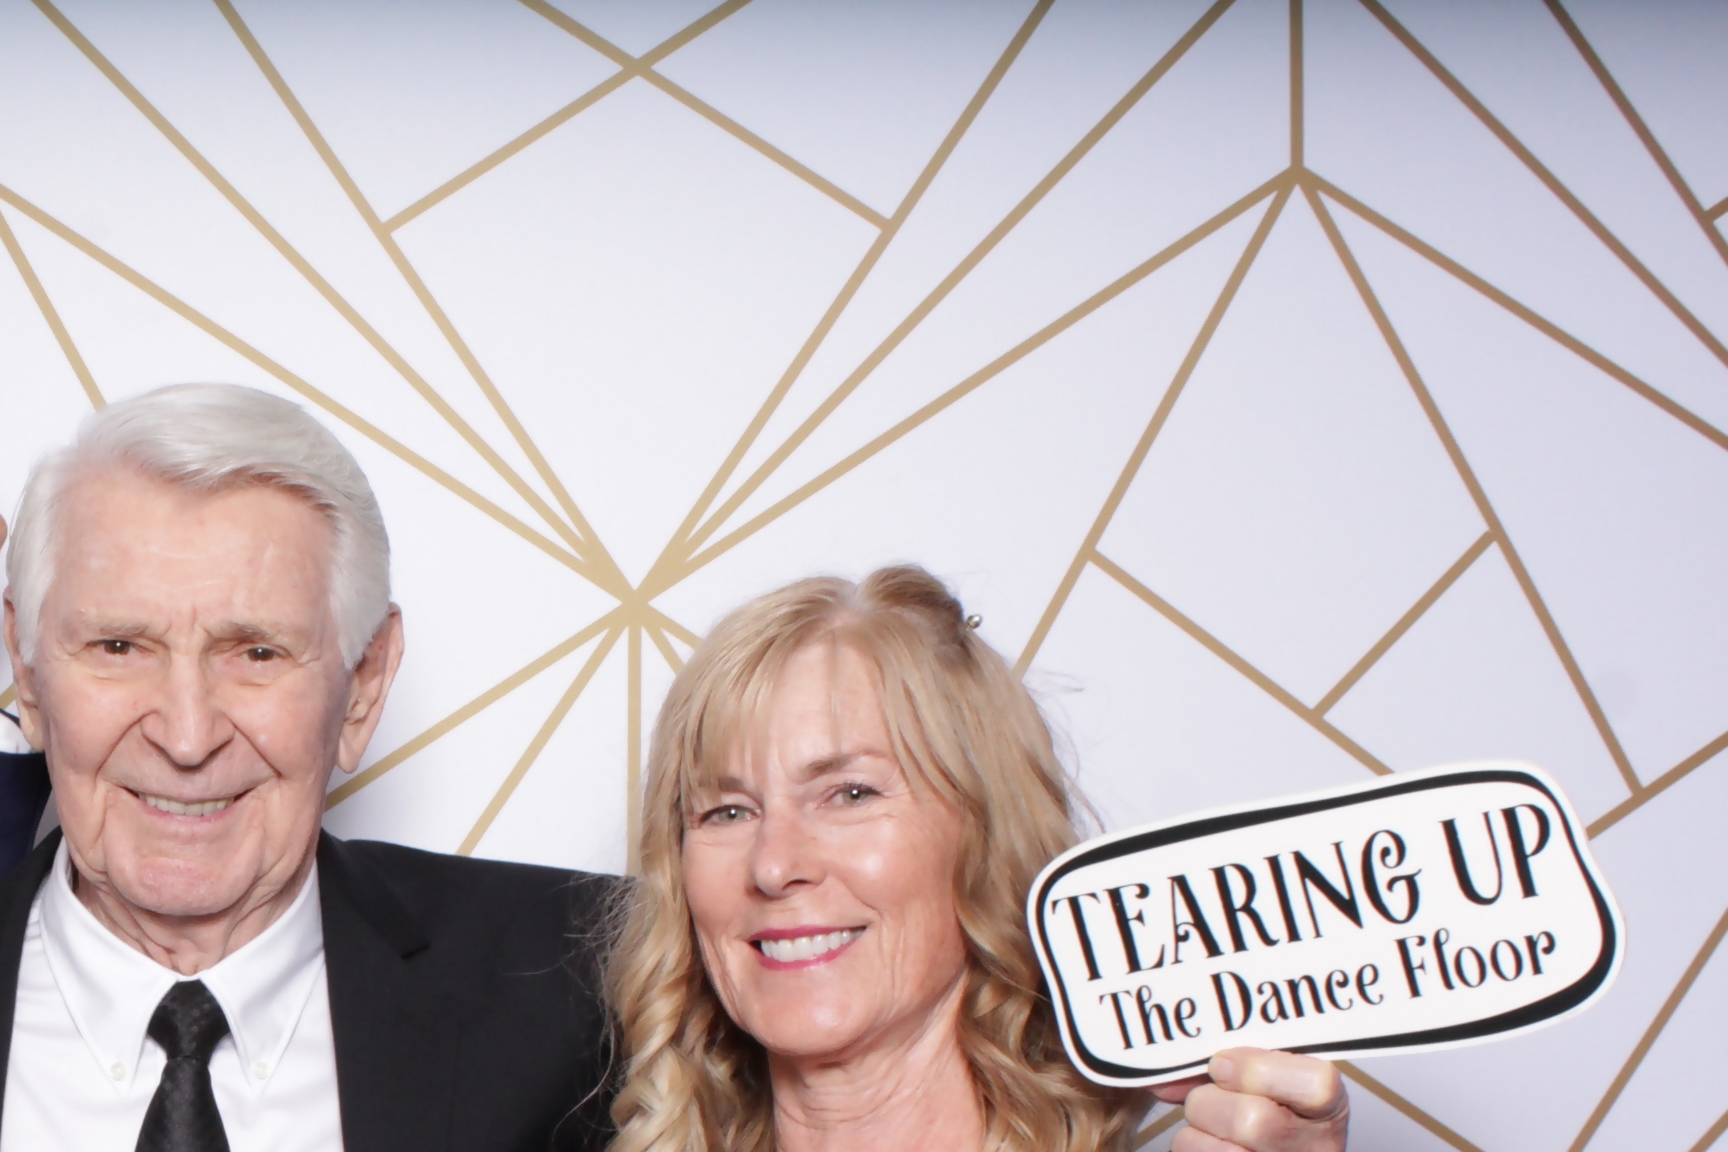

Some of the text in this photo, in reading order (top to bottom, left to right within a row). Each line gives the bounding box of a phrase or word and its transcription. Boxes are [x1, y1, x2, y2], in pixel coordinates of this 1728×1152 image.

[1051, 803, 1551, 982] TEARING UP
[1098, 927, 1557, 1050] The Dance Floor
